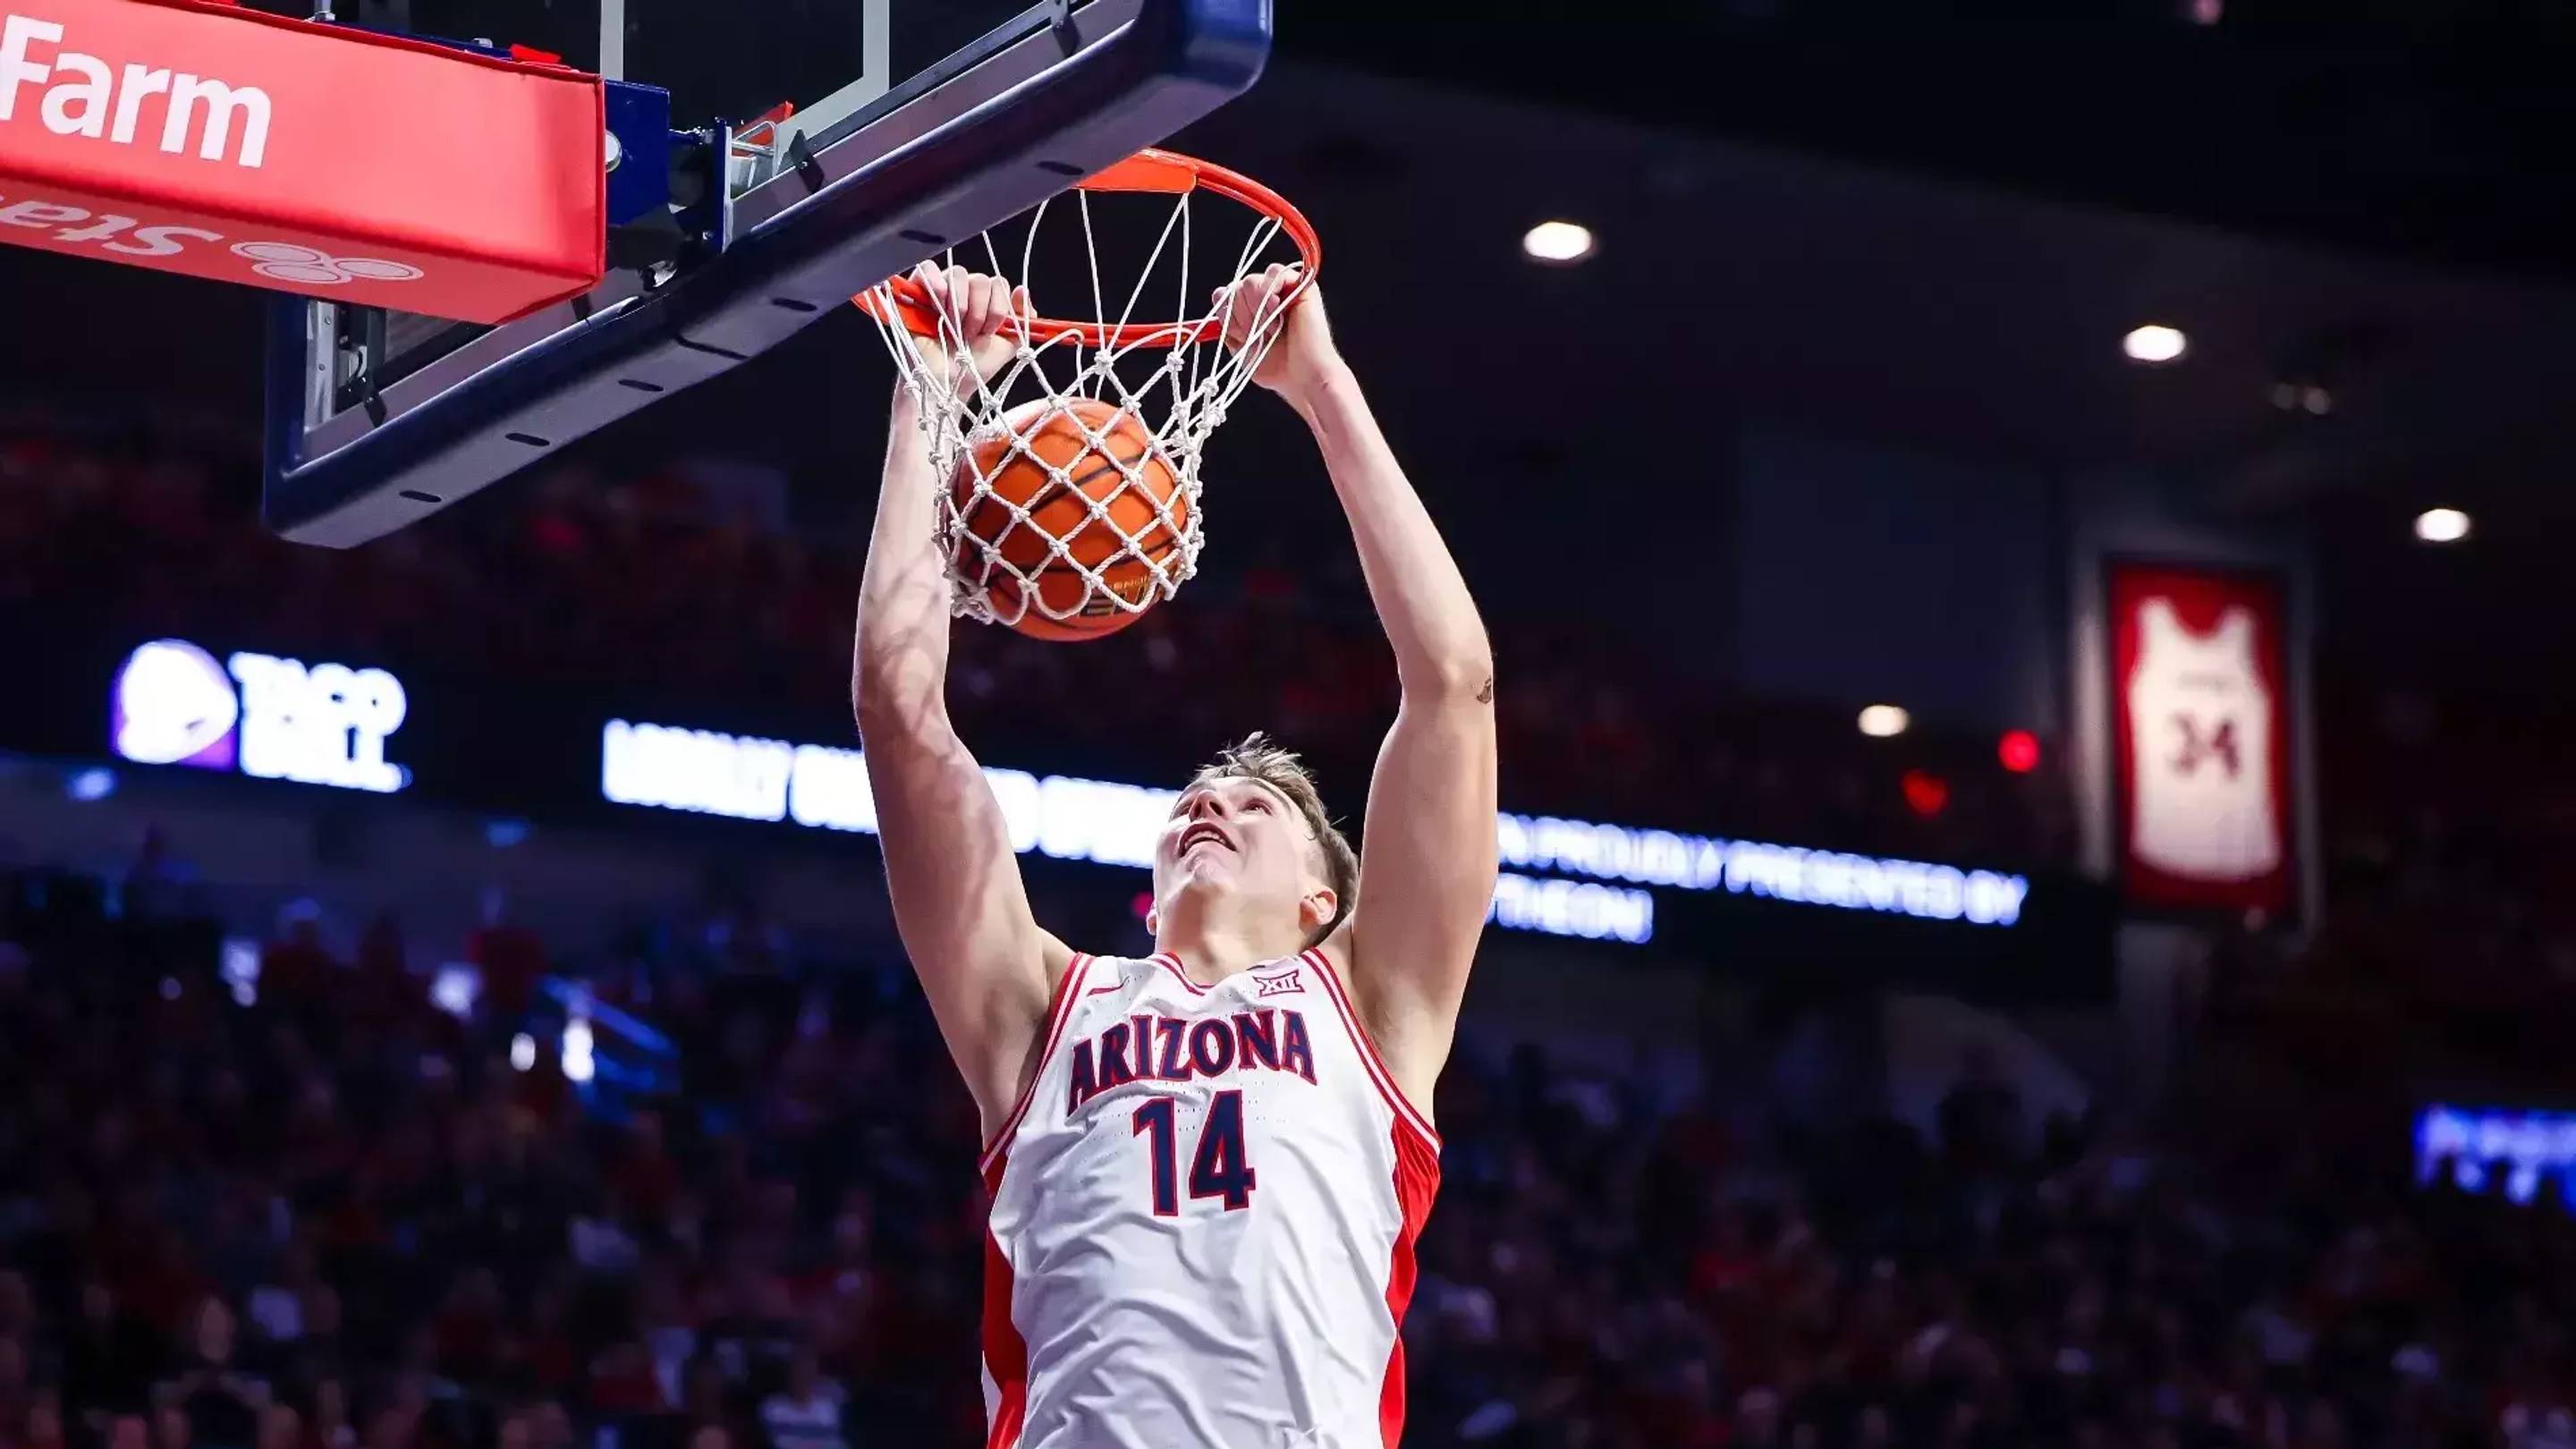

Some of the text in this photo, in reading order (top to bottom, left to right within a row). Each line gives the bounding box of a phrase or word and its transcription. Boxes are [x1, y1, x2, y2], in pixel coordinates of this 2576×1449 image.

[0, 14, 272, 168] Farm
[0, 194, 224, 256] Sta
[1253, 970, 1305, 997] XII
[1066, 1009, 1318, 1118] ARIZONA
[1132, 1089, 1256, 1217] 14
